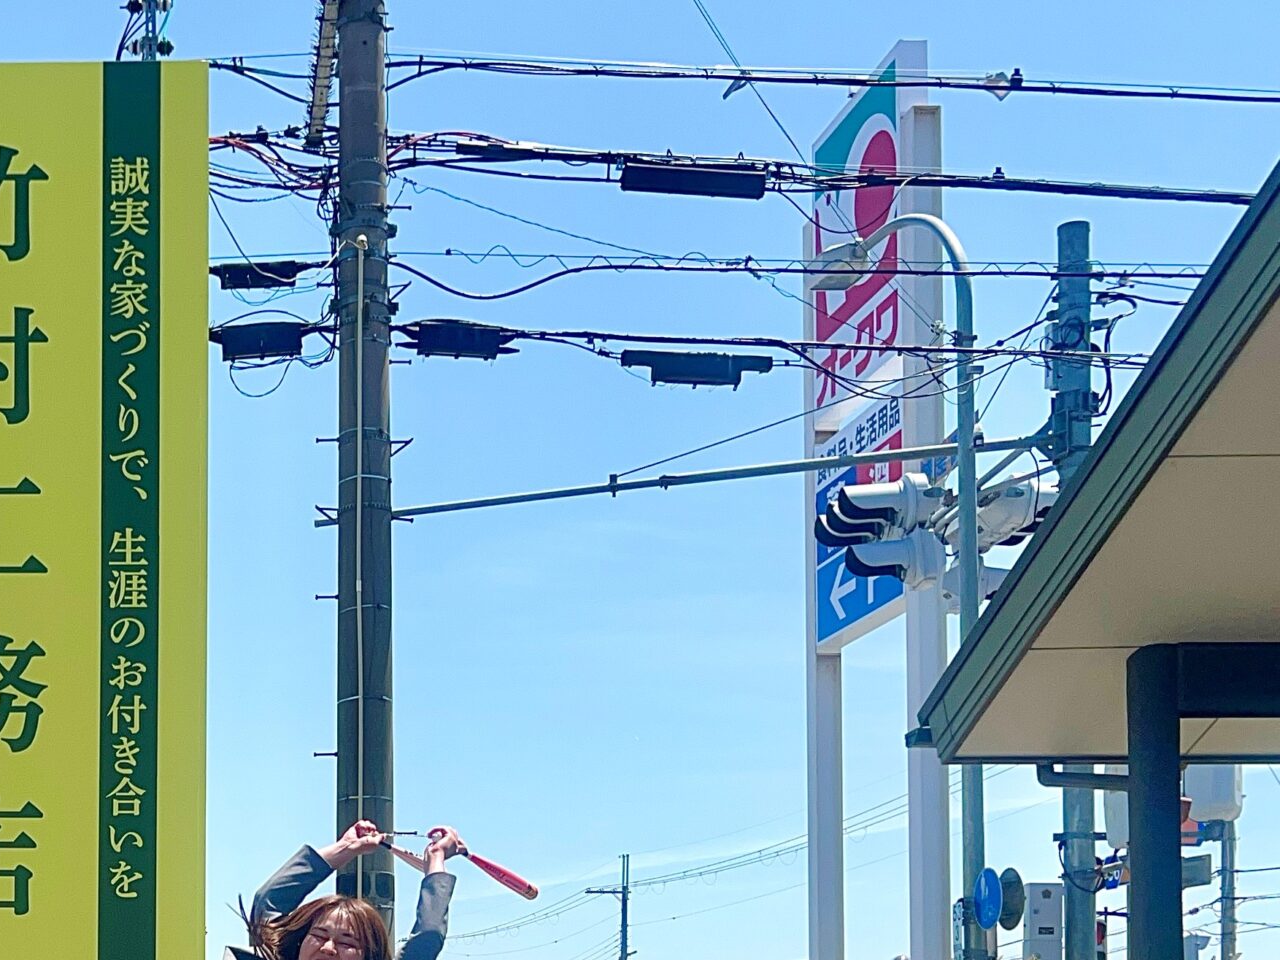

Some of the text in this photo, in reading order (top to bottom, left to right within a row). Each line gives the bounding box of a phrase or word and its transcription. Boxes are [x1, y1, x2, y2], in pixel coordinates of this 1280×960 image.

[105, 155, 151, 901] 誠実な家づくりで、生涯のお付き合いを
[816, 288, 898, 408] オークワ
